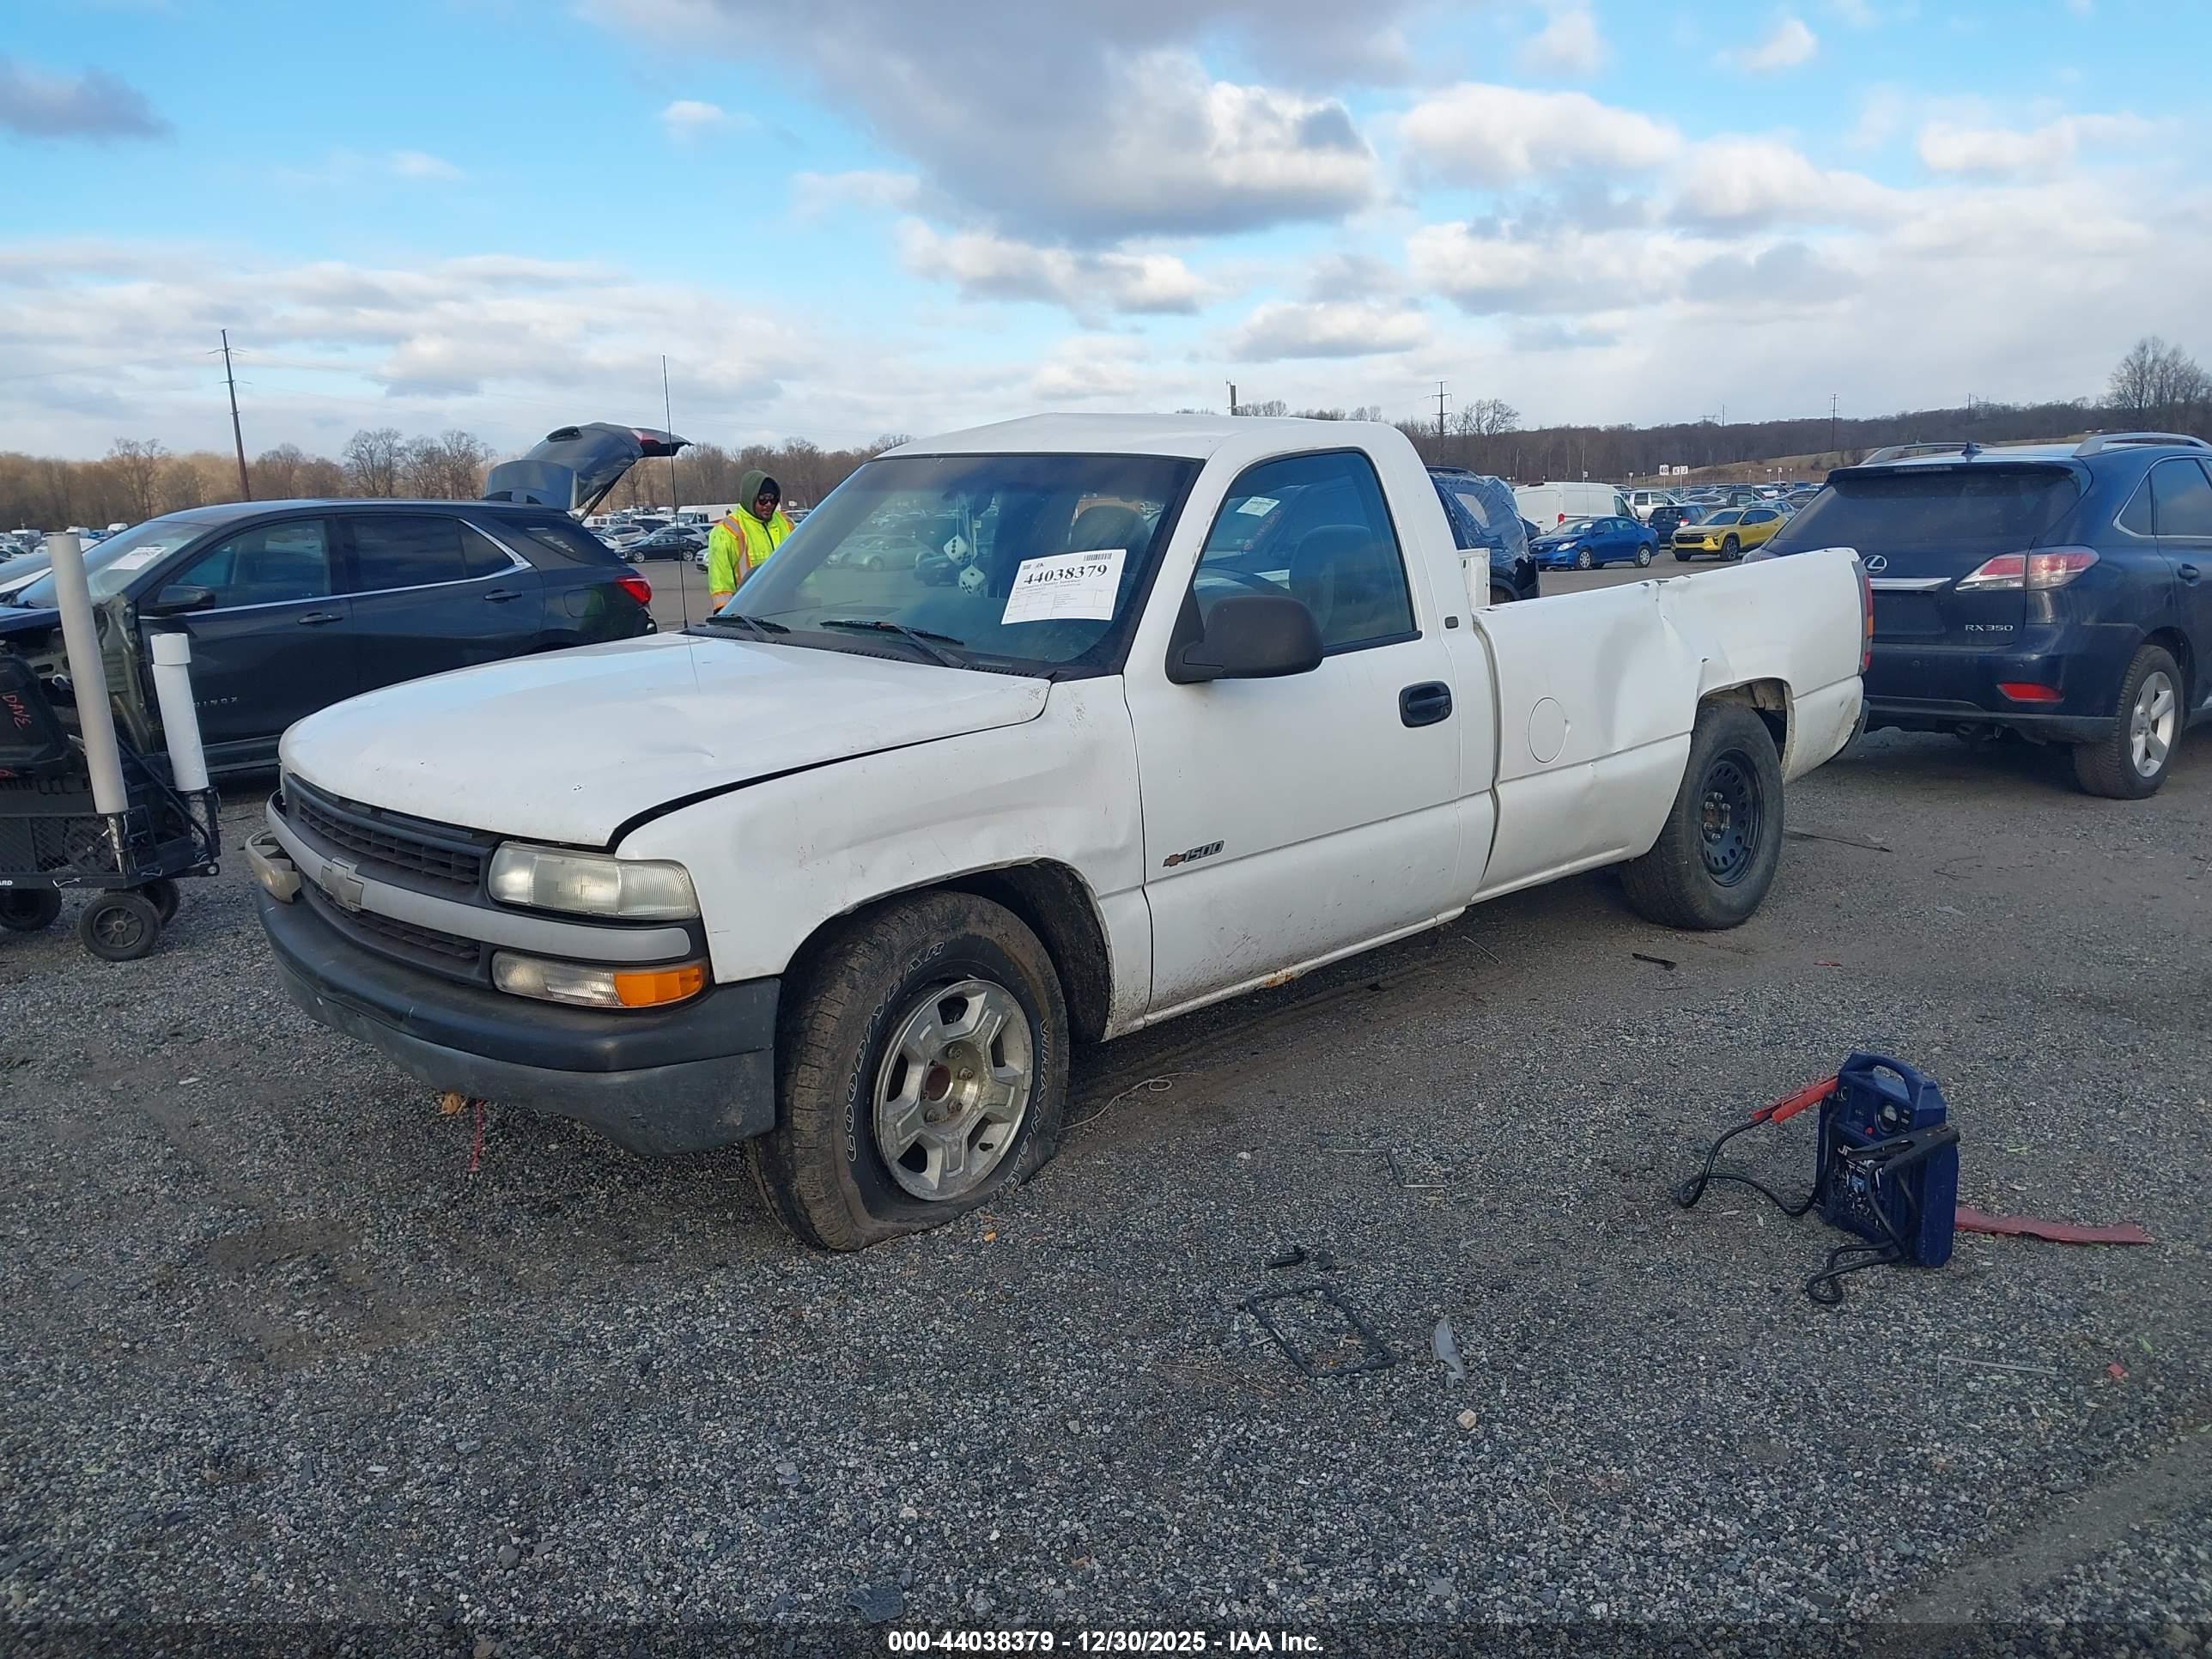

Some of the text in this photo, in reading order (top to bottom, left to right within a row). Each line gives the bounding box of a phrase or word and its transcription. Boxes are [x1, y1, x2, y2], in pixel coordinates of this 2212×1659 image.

[1024, 564, 1108, 585] 44038379
[1184, 840, 1224, 863] 1500
[843, 940, 945, 1163] GOODYEAR
[989, 1018, 1051, 1200] WRANGLER
